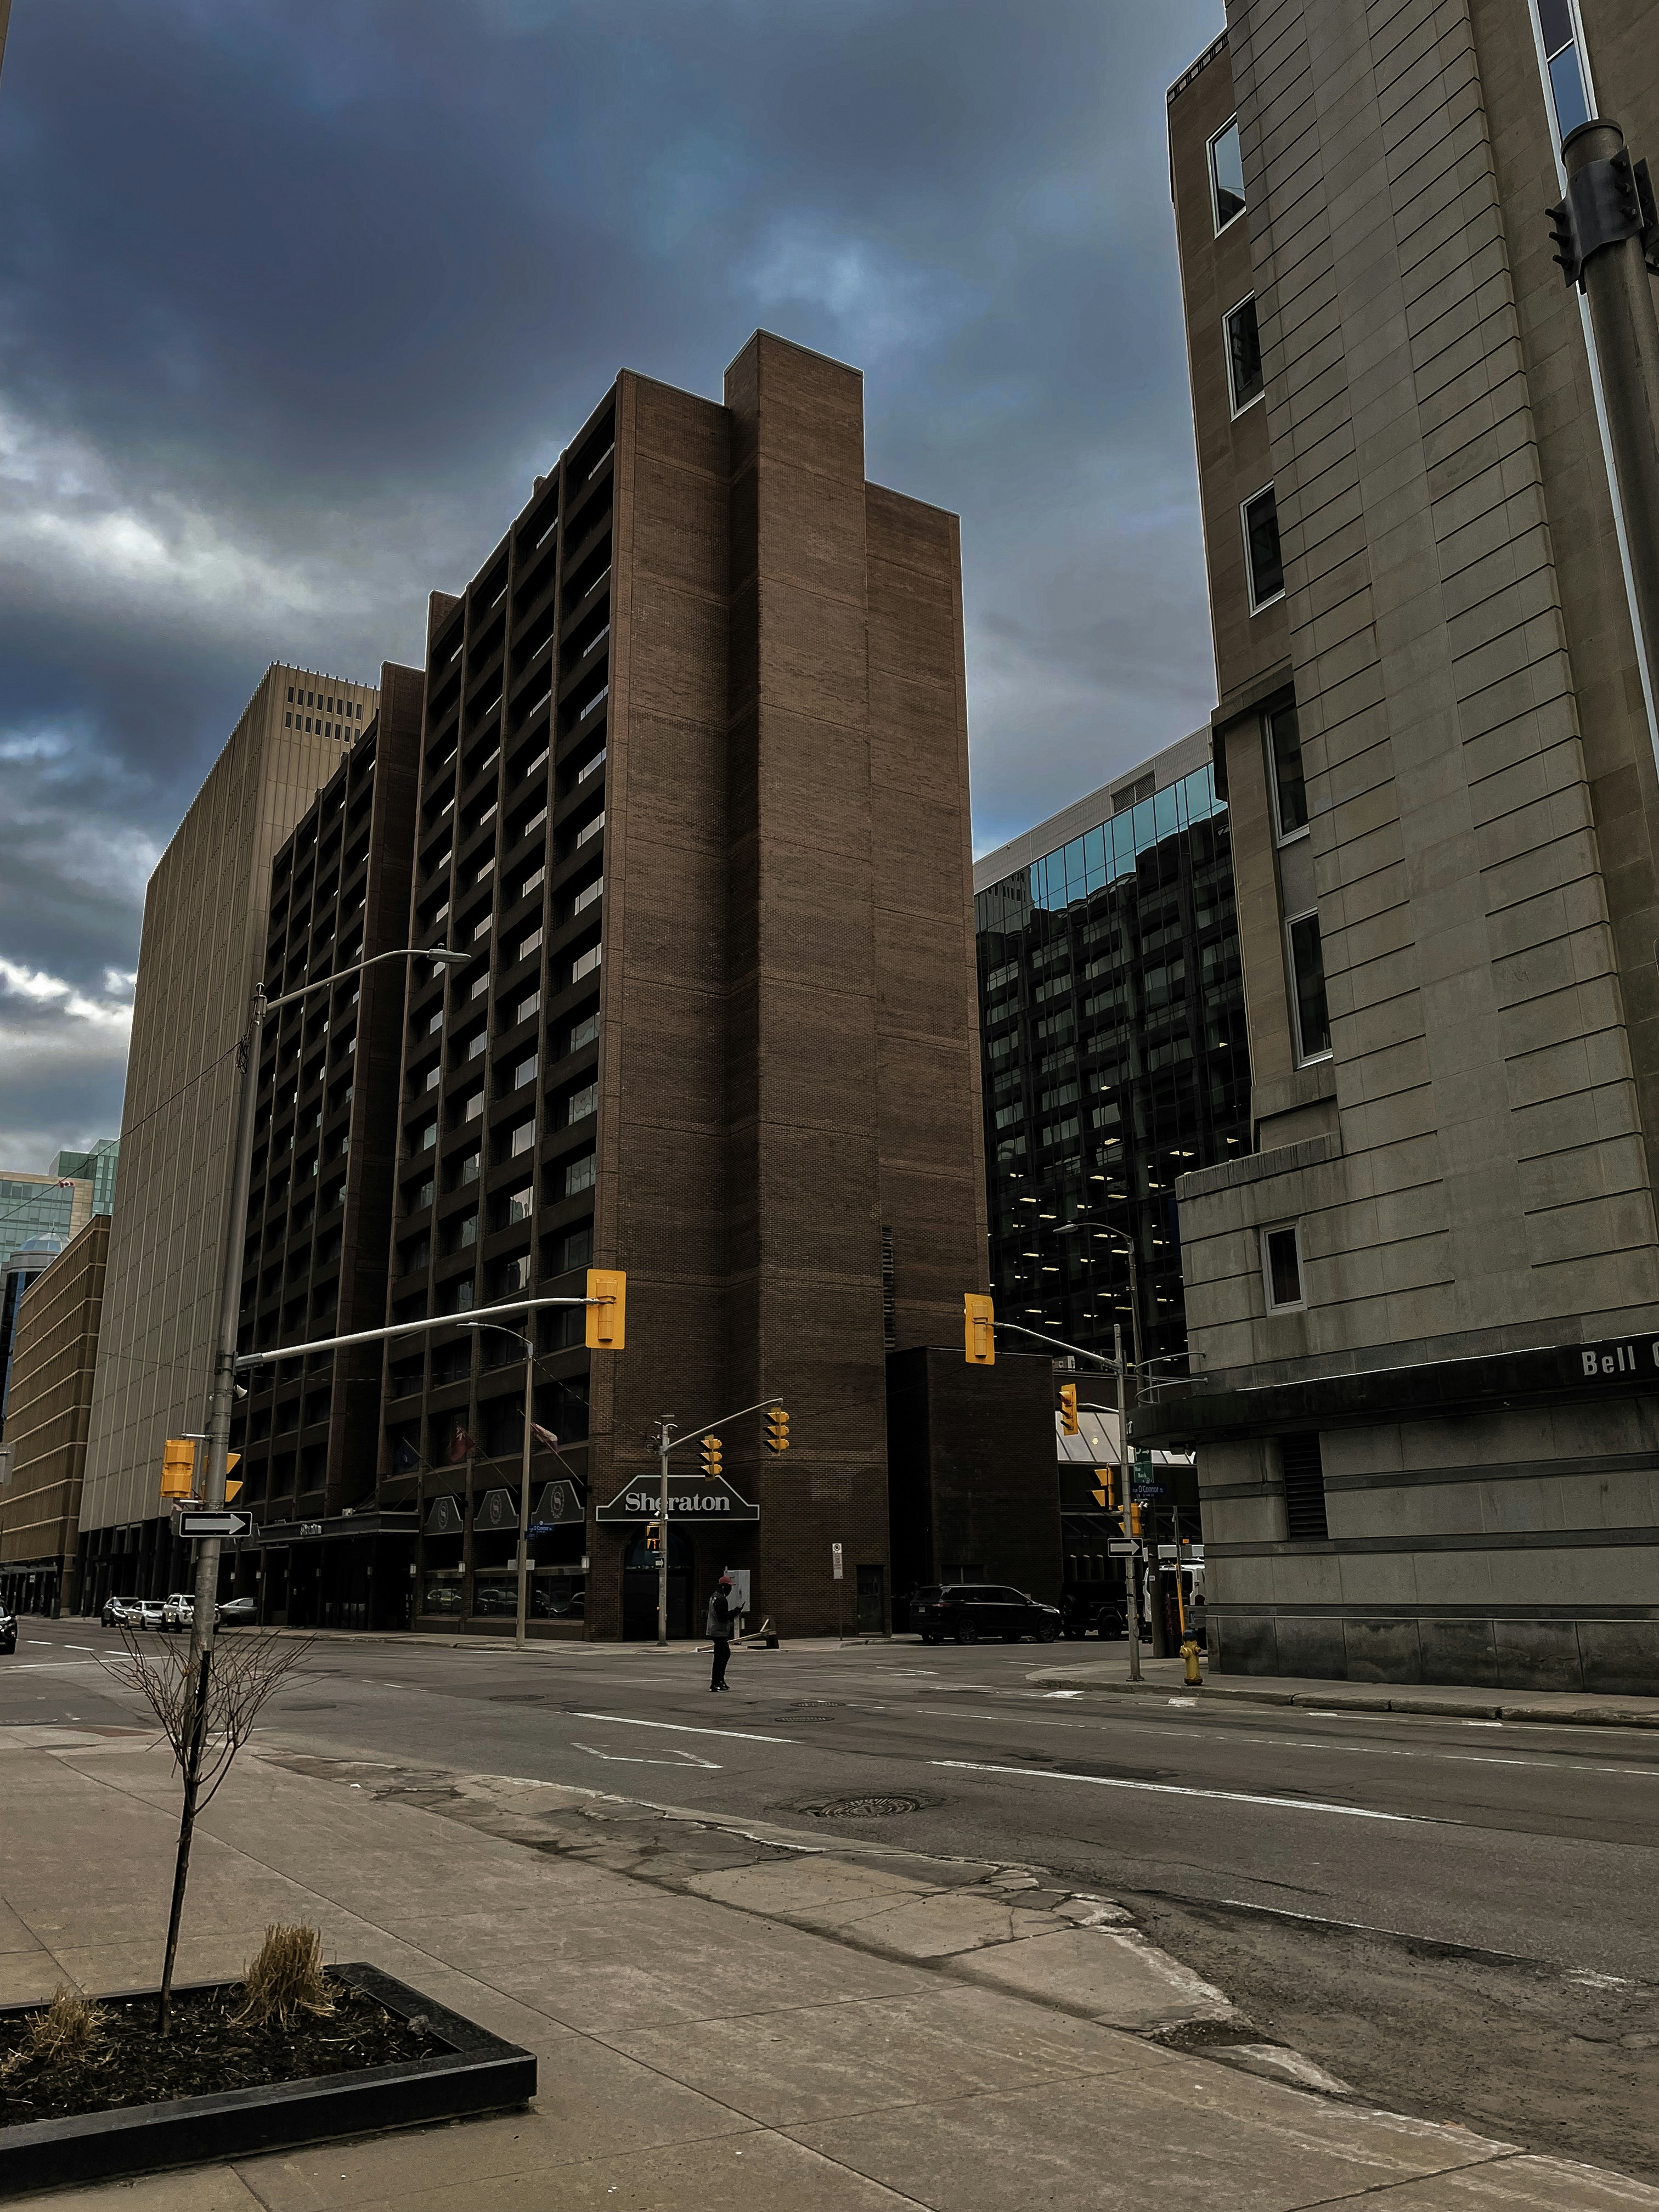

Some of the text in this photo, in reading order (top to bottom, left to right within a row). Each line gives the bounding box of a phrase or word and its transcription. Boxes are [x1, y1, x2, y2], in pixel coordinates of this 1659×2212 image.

[1581, 1346, 1636, 1376] Bell
[554, 1491, 562, 1511] S
[625, 1492, 730, 1511] Sheraton
